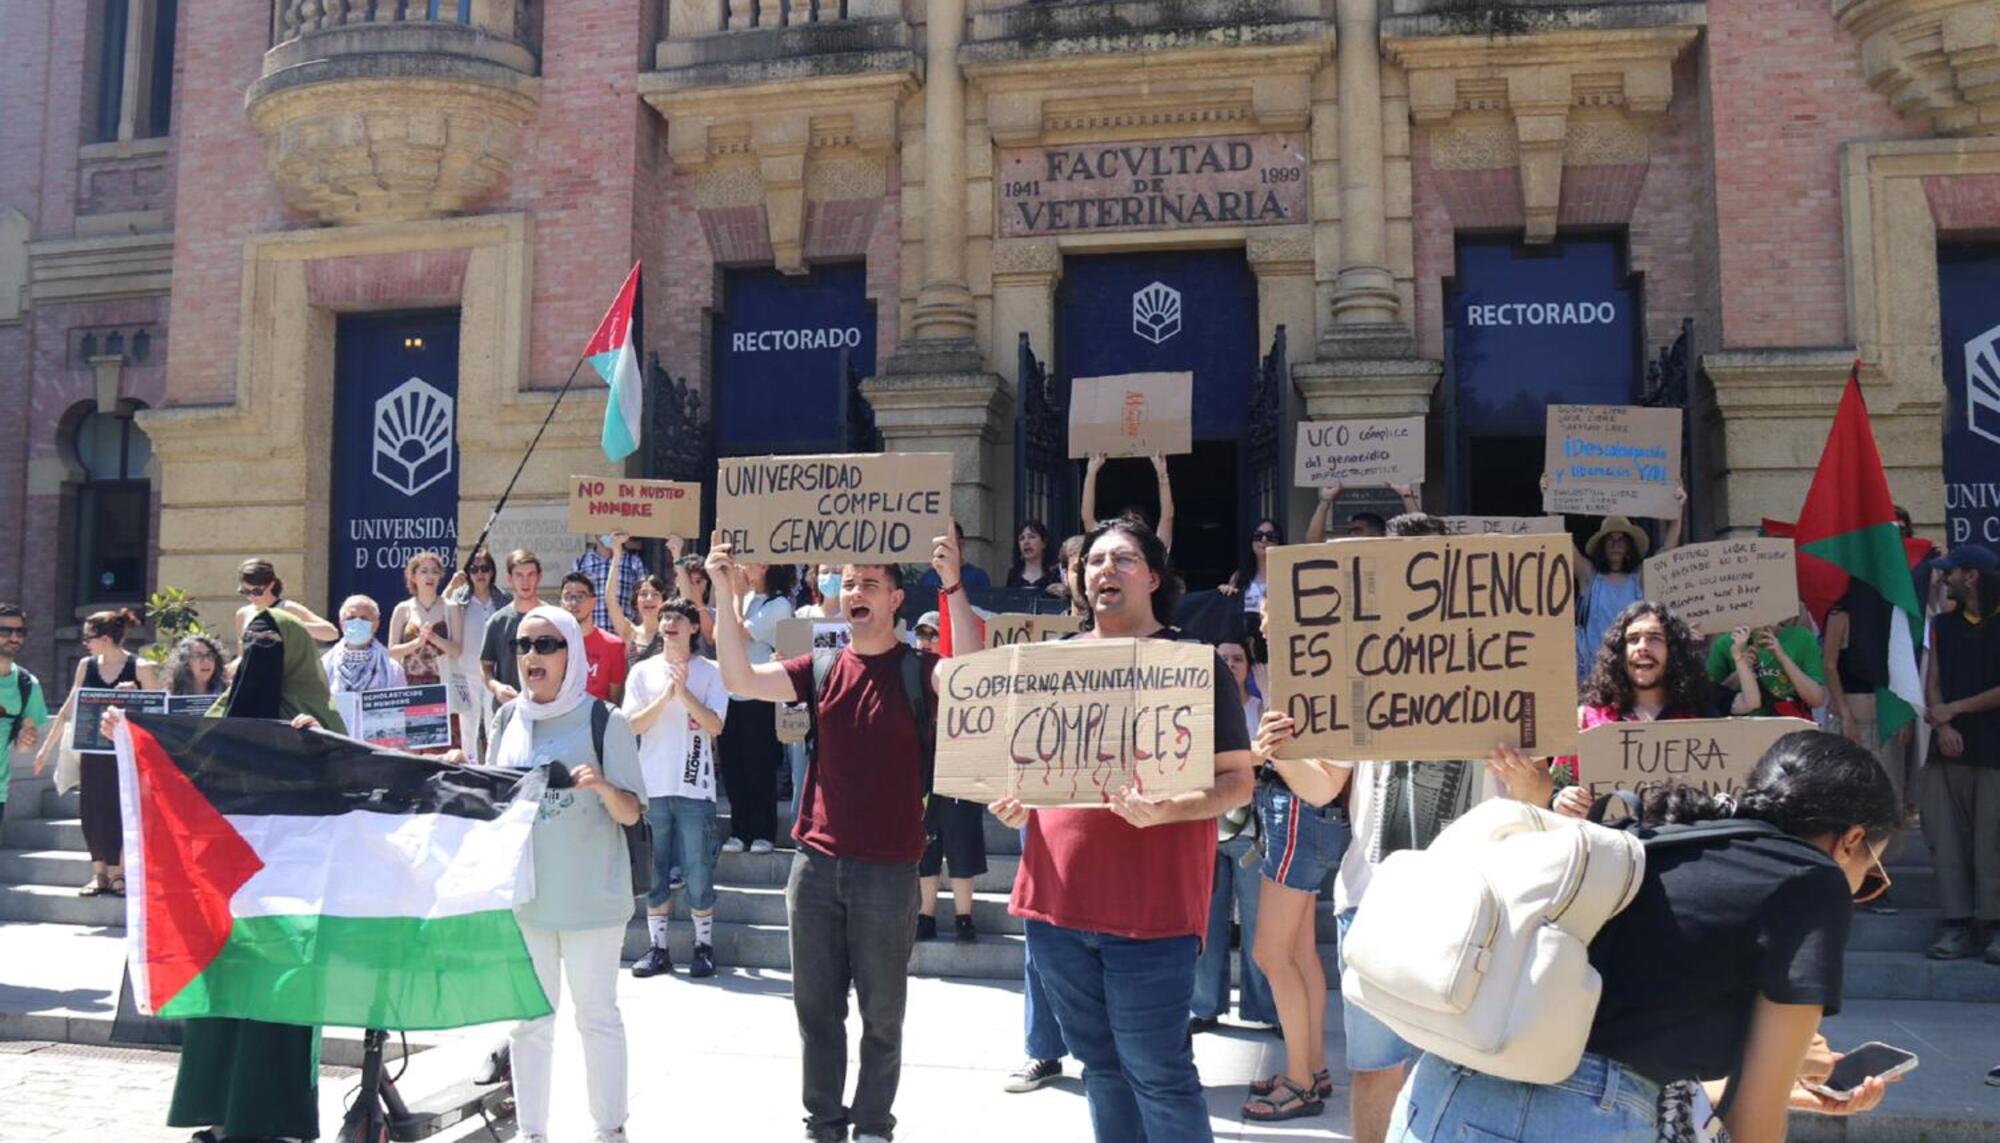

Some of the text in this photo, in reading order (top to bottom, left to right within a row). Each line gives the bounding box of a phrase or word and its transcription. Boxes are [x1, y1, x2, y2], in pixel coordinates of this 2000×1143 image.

[1045, 142, 1254, 181] FACVLTAD
[1134, 179, 1164, 194] DE
[1260, 168, 1300, 183] 1999
[1004, 181, 1040, 197] 1941
[1017, 190, 1286, 230] VETERINARIA
[1468, 302, 1615, 326] RECTORADO
[733, 328, 861, 352] RECTORADO
[1307, 425, 1409, 447] UCO cómplice
[1305, 450, 1390, 471] del genocidio
[578, 482, 605, 498] NO
[619, 484, 635, 498] EN
[726, 463, 862, 496] UNIVERSIDAD
[589, 501, 652, 517] NOMBRE
[351, 517, 458, 541] UNIVERSIDA
[721, 518, 911, 555] DEL GENOCIDIO
[1483, 521, 1503, 533] DE
[1512, 522, 1530, 533] LA
[1722, 543, 1758, 555] LIBRE
[1292, 543, 1572, 627] EL SILENCIO
[1290, 626, 1536, 677] ES CÓMPLICE
[1288, 693, 1349, 738] DEL
[1366, 684, 1524, 731] GENOCIDIO
[947, 702, 1192, 768] UCO CÓMPLICES
[1619, 729, 1729, 773] FUERA
